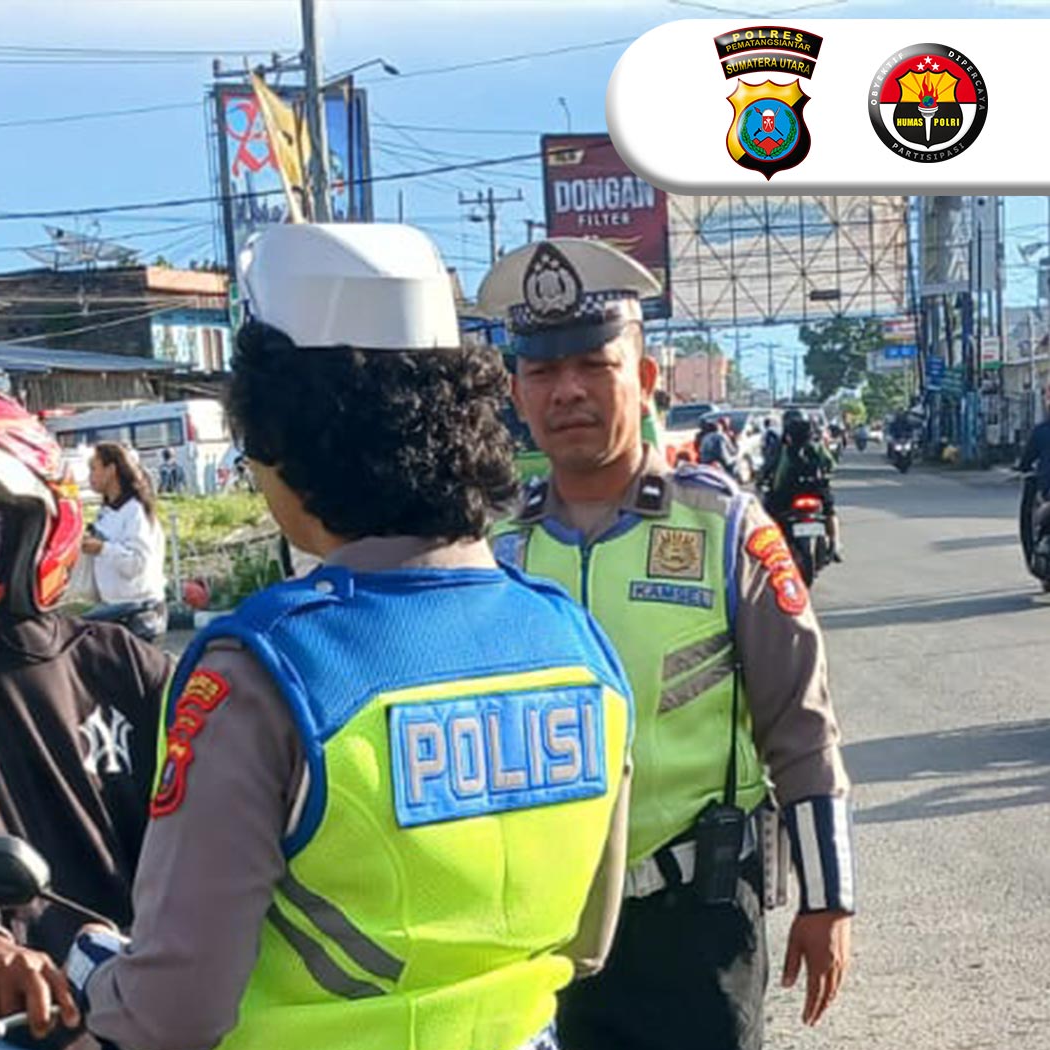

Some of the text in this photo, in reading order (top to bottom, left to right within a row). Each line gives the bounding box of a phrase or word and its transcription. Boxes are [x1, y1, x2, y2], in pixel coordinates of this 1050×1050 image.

[553, 176, 655, 213] DONGAN
[578, 212, 631, 227] FILTER
[405, 702, 598, 804] POLISI
